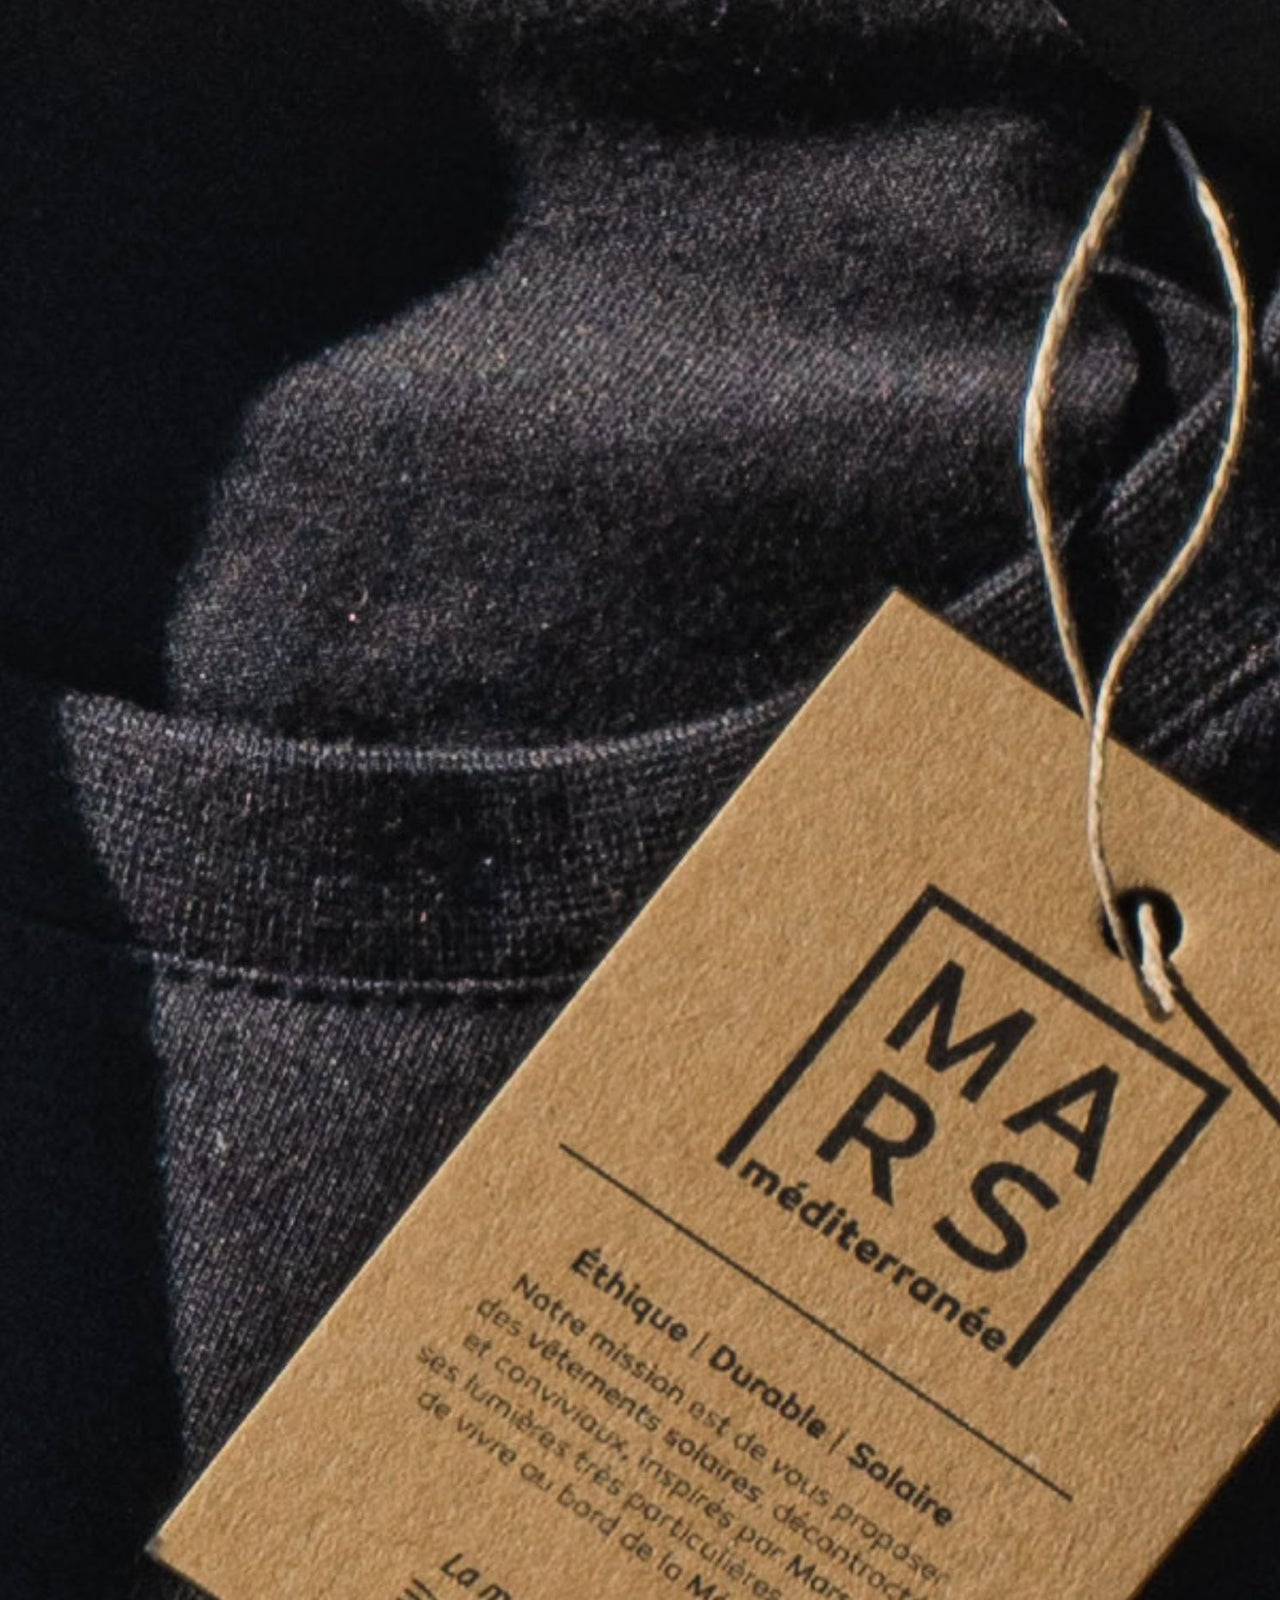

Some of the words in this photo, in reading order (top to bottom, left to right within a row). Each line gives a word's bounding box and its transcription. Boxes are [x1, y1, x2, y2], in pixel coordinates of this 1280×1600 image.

[738, 1157, 1008, 1354] méditerranée
[416, 1345, 459, 1385] ses
[464, 1373, 568, 1459] lumières
[574, 1450, 623, 1497] très
[417, 1389, 451, 1421] de
[456, 1416, 517, 1467] vivre
[519, 1461, 553, 1492] au
[556, 1482, 622, 1538] bord
[620, 1529, 655, 1562] de
[656, 1551, 683, 1582] la
[462, 1331, 492, 1359] et
[494, 1355, 630, 1462] conviviaux,
[636, 1450, 735, 1529] inspirés
[734, 1524, 787, 1560] par
[476, 1297, 523, 1338] des
[528, 1330, 662, 1433] vêtements
[772, 1503, 930, 1600] décontract
[512, 1272, 587, 1338] Notre
[589, 1330, 685, 1405] mission
[688, 1400, 732, 1438] est
[733, 1428, 768, 1463] de
[772, 1457, 831, 1508] vous
[830, 1503, 950, 1588] proposer
[570, 1247, 689, 1344] Éthique
[707, 1343, 828, 1440] Durable
[847, 1441, 954, 1527] Solaire
[441, 1552, 480, 1588] La
